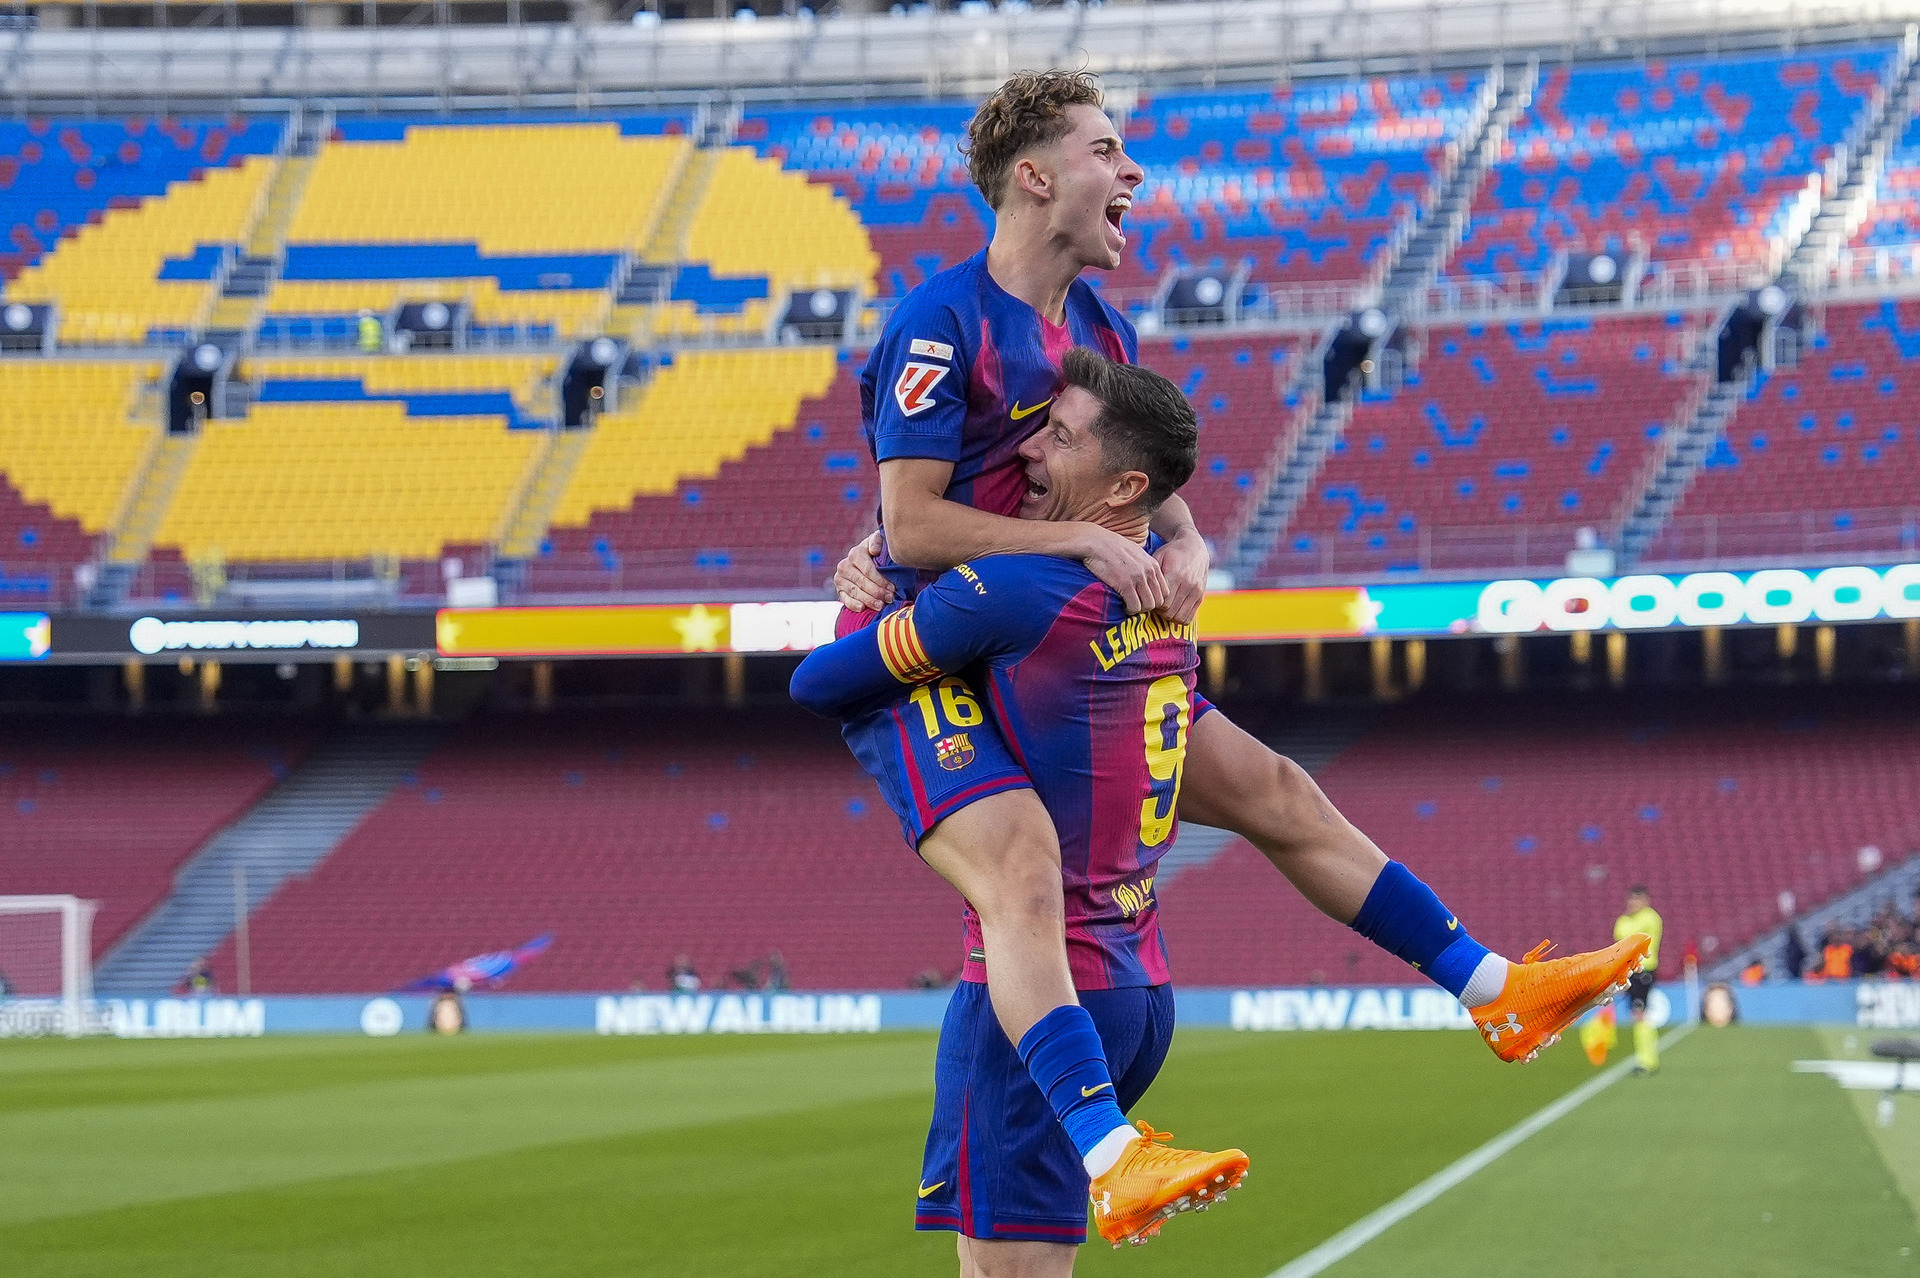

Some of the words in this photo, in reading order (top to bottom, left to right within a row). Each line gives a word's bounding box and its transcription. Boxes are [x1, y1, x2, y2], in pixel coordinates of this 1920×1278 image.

[909, 676, 984, 740] 16
[1139, 675, 1188, 847] 9
[595, 994, 716, 1036] NEW
[705, 994, 882, 1035] ALBUM
[1230, 989, 1353, 1031] NEW
